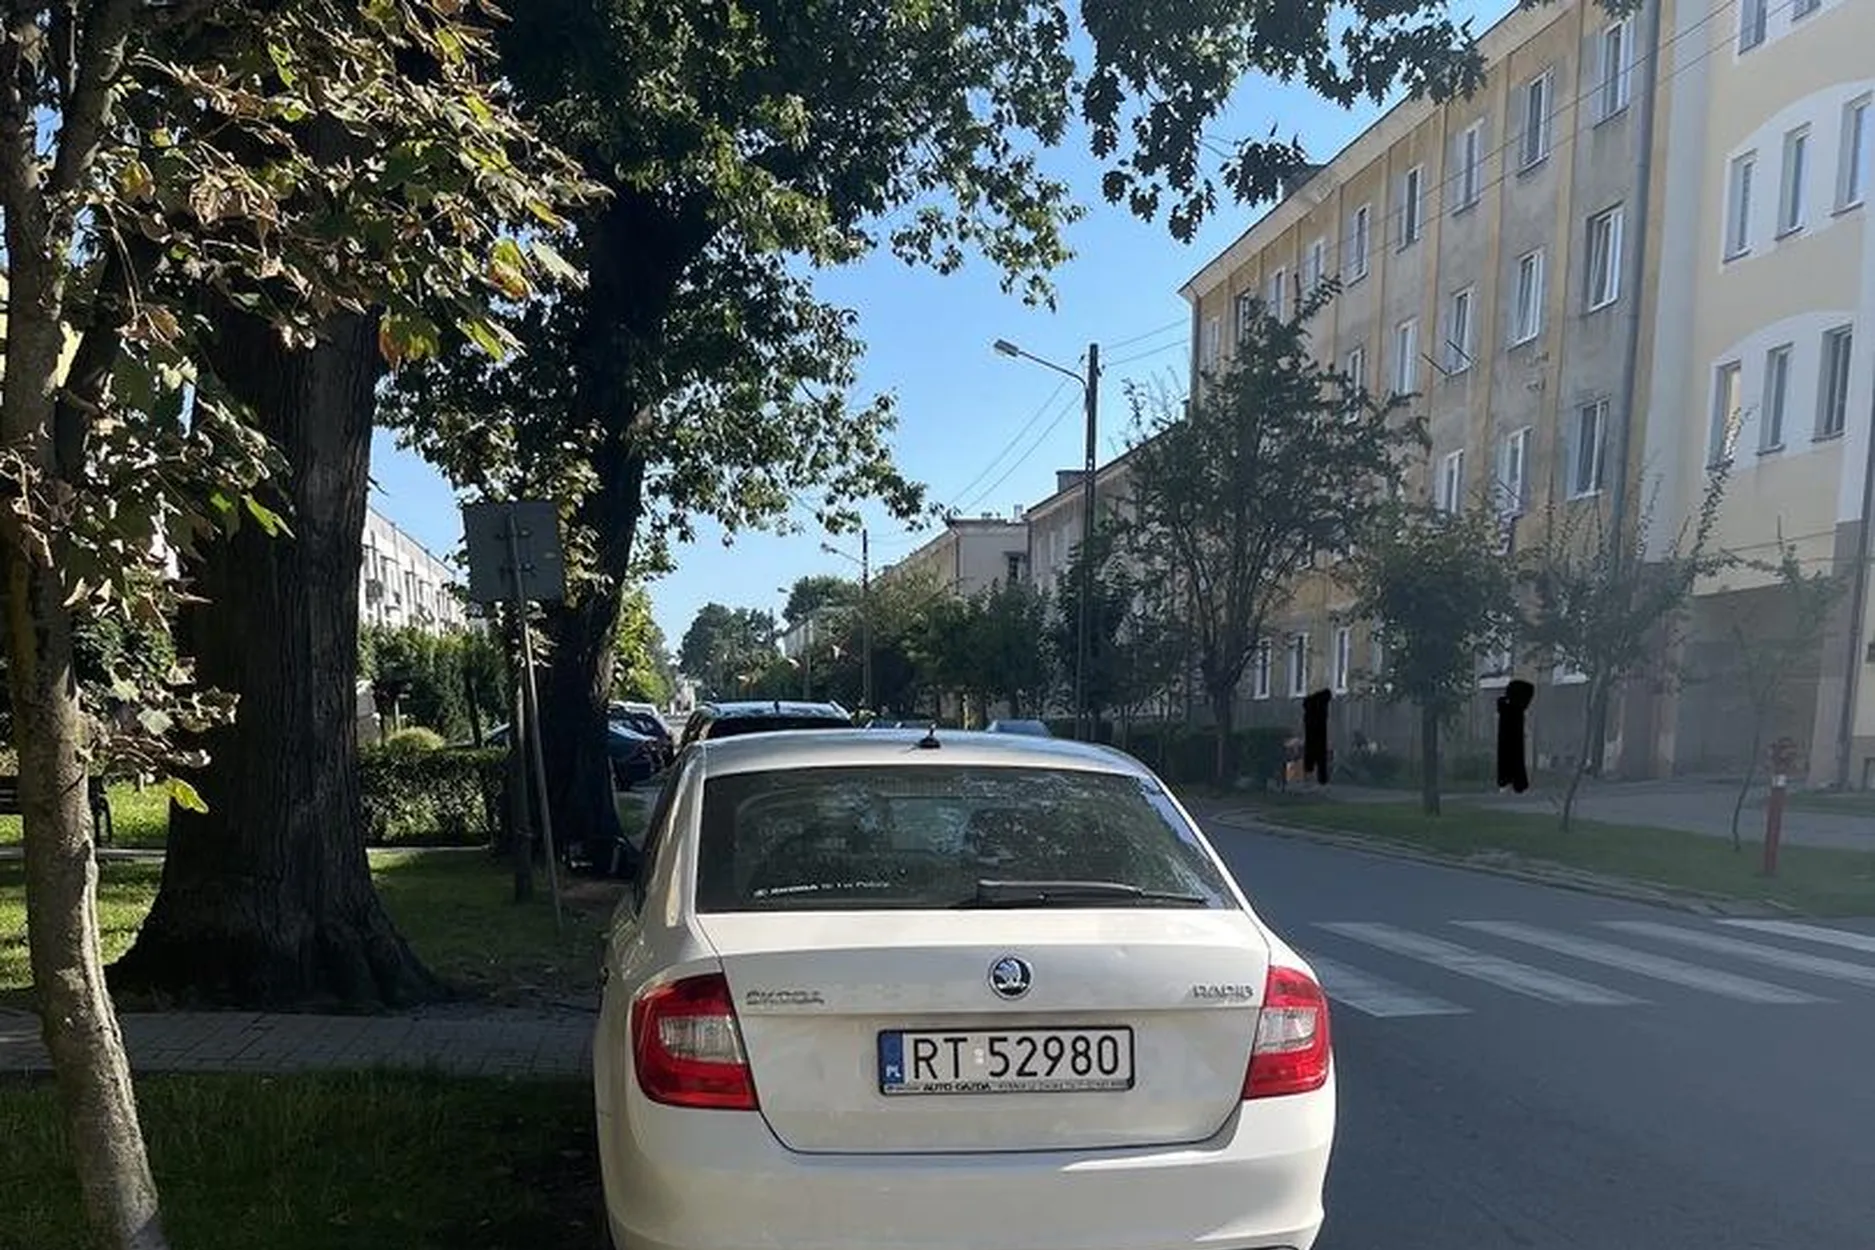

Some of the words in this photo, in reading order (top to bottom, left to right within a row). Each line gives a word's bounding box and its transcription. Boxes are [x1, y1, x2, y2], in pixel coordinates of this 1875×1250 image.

[913, 1038, 968, 1079] RT
[988, 1035, 1119, 1077] 52980
[886, 1065, 901, 1077] PL
[923, 1082, 952, 1092] AUTO
